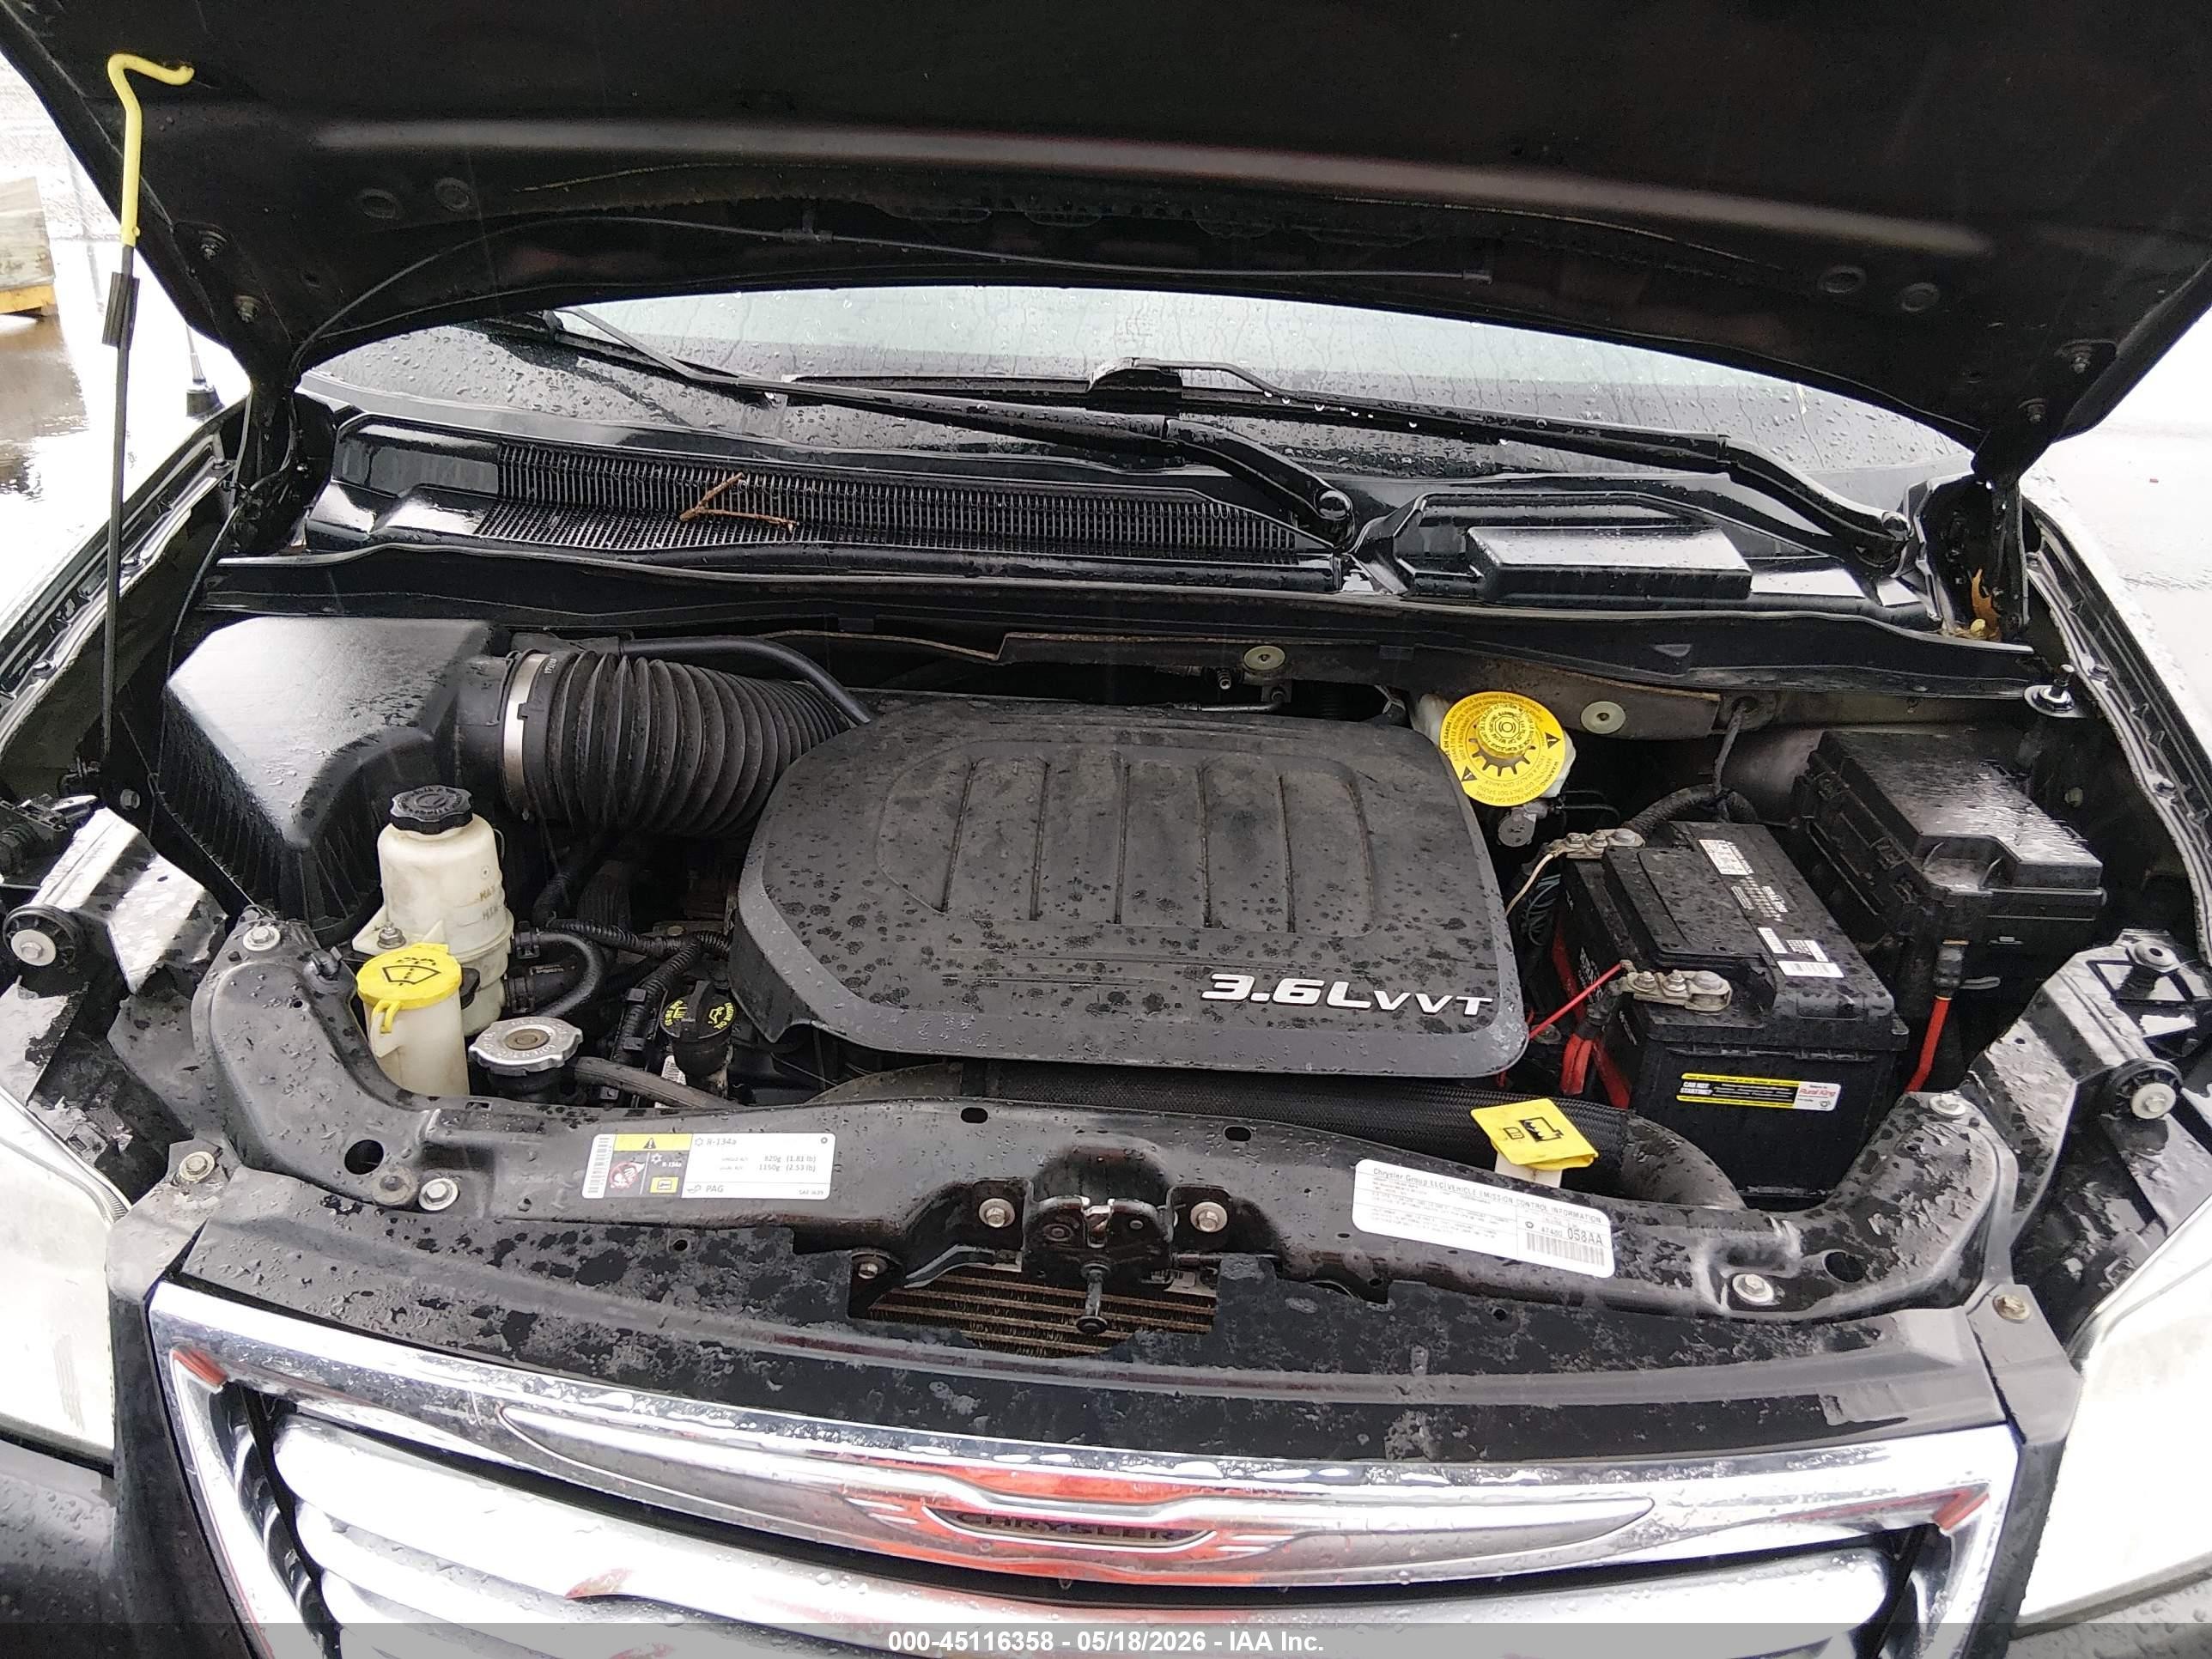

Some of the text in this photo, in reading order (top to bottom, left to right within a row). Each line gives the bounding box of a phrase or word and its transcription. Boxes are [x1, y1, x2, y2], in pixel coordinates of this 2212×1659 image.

[714, 1002, 735, 1030] ENGINE OIL
[1373, 1168, 1403, 1179] Chrysler
[1406, 1175, 1427, 1186] Group
[1567, 1228, 1603, 1245] 058AA
